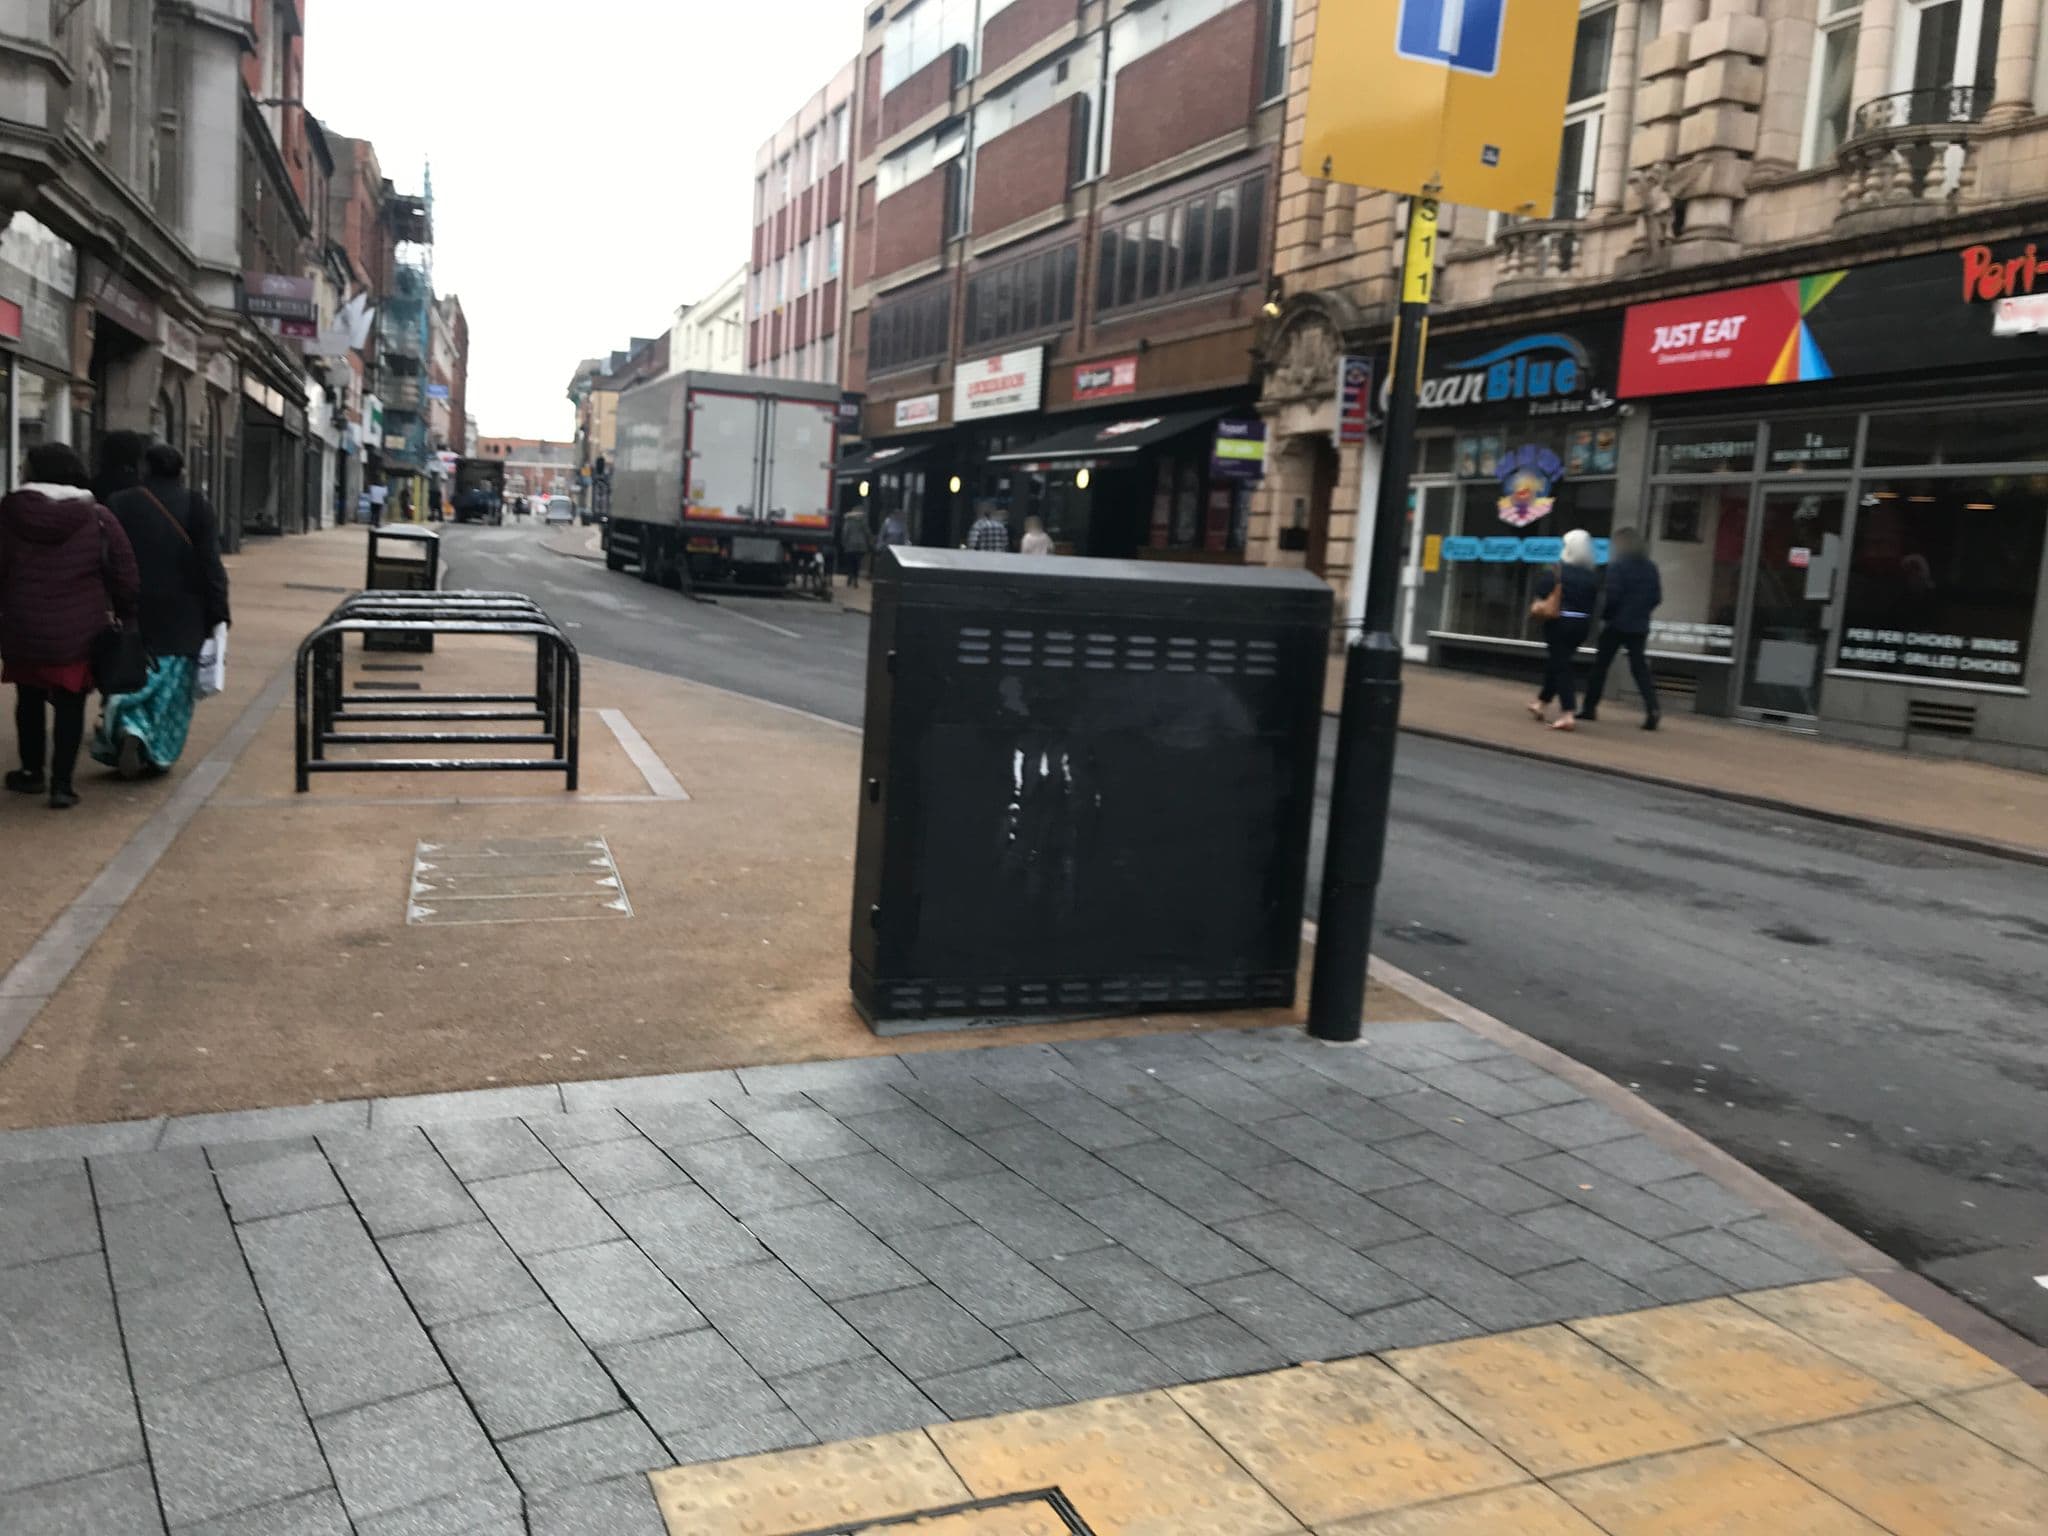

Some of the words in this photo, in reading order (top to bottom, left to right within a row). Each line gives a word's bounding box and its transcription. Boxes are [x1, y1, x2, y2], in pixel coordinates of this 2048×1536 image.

[1650, 321, 1702, 354] JUST
[1702, 314, 1748, 345] EAT
[1906, 631, 1963, 649] CHICKEN
[1971, 637, 2020, 654] WINGS
[1840, 646, 1897, 664] BURGERS
[1903, 651, 1958, 669] GRILLED
[1959, 656, 2022, 675] CHICKEN
